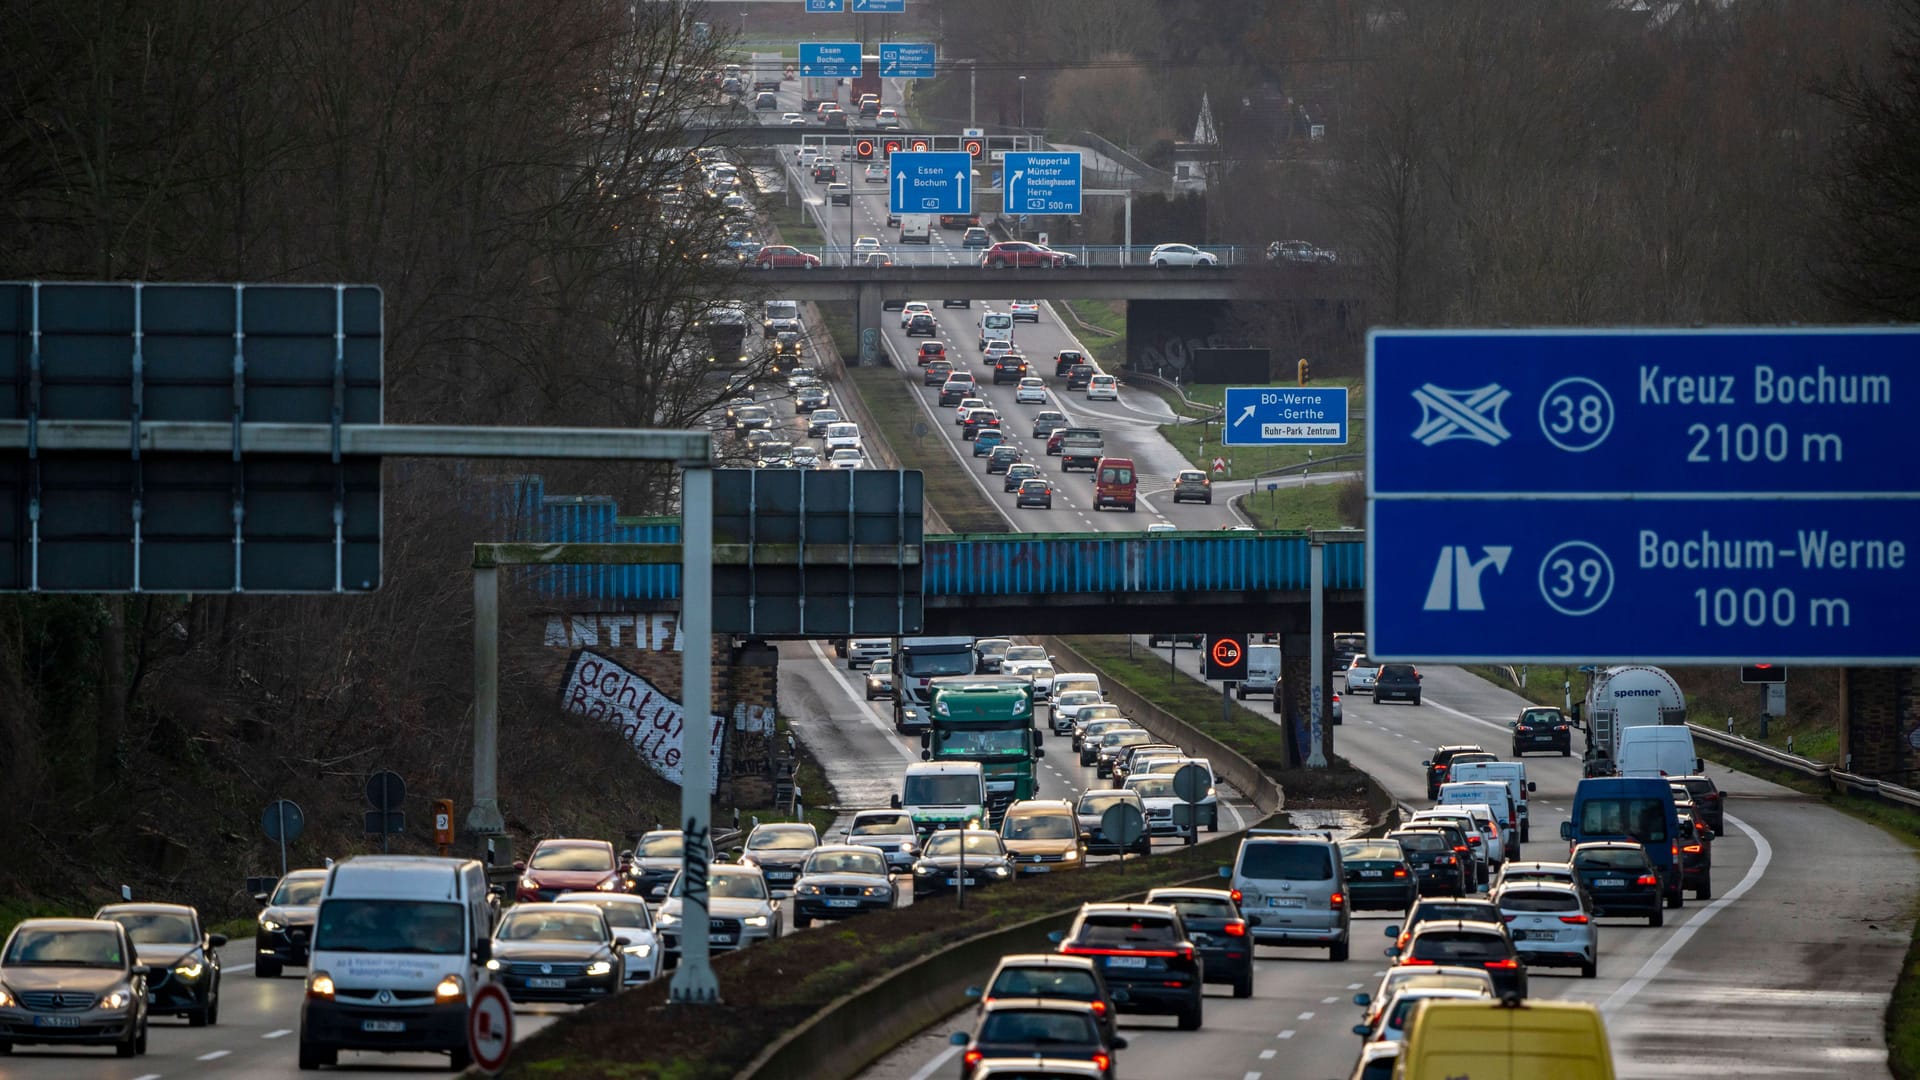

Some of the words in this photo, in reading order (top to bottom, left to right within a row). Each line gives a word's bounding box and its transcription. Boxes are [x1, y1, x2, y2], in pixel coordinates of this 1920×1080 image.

[819, 46, 841, 54] Essen
[1027, 157, 1071, 167] Wuppertal
[918, 166, 944, 175] Essen
[1027, 166, 1062, 176] Münster
[914, 178, 948, 187] Bochum
[1027, 178, 1076, 187] Recklinghausen
[1027, 188, 1053, 196] Herne
[1048, 201, 1064, 210] 500
[1639, 365, 1735, 404] Kreuz
[1754, 365, 1892, 404] Bochum
[1261, 393, 1322, 405] BO-Werne
[1278, 408, 1325, 420] -Gerthe
[1550, 395, 1603, 434] 38
[1264, 426, 1304, 436] Ruhr-Park
[1306, 426, 1338, 436] Zentrum
[1686, 423, 1789, 463] 2100
[1802, 432, 1843, 463] m
[1639, 529, 1906, 570] Bochum-Werne
[1550, 558, 1603, 598] 39
[1694, 587, 1796, 628] 1000
[1809, 597, 1851, 628] m
[1613, 689, 1662, 699] spenner
